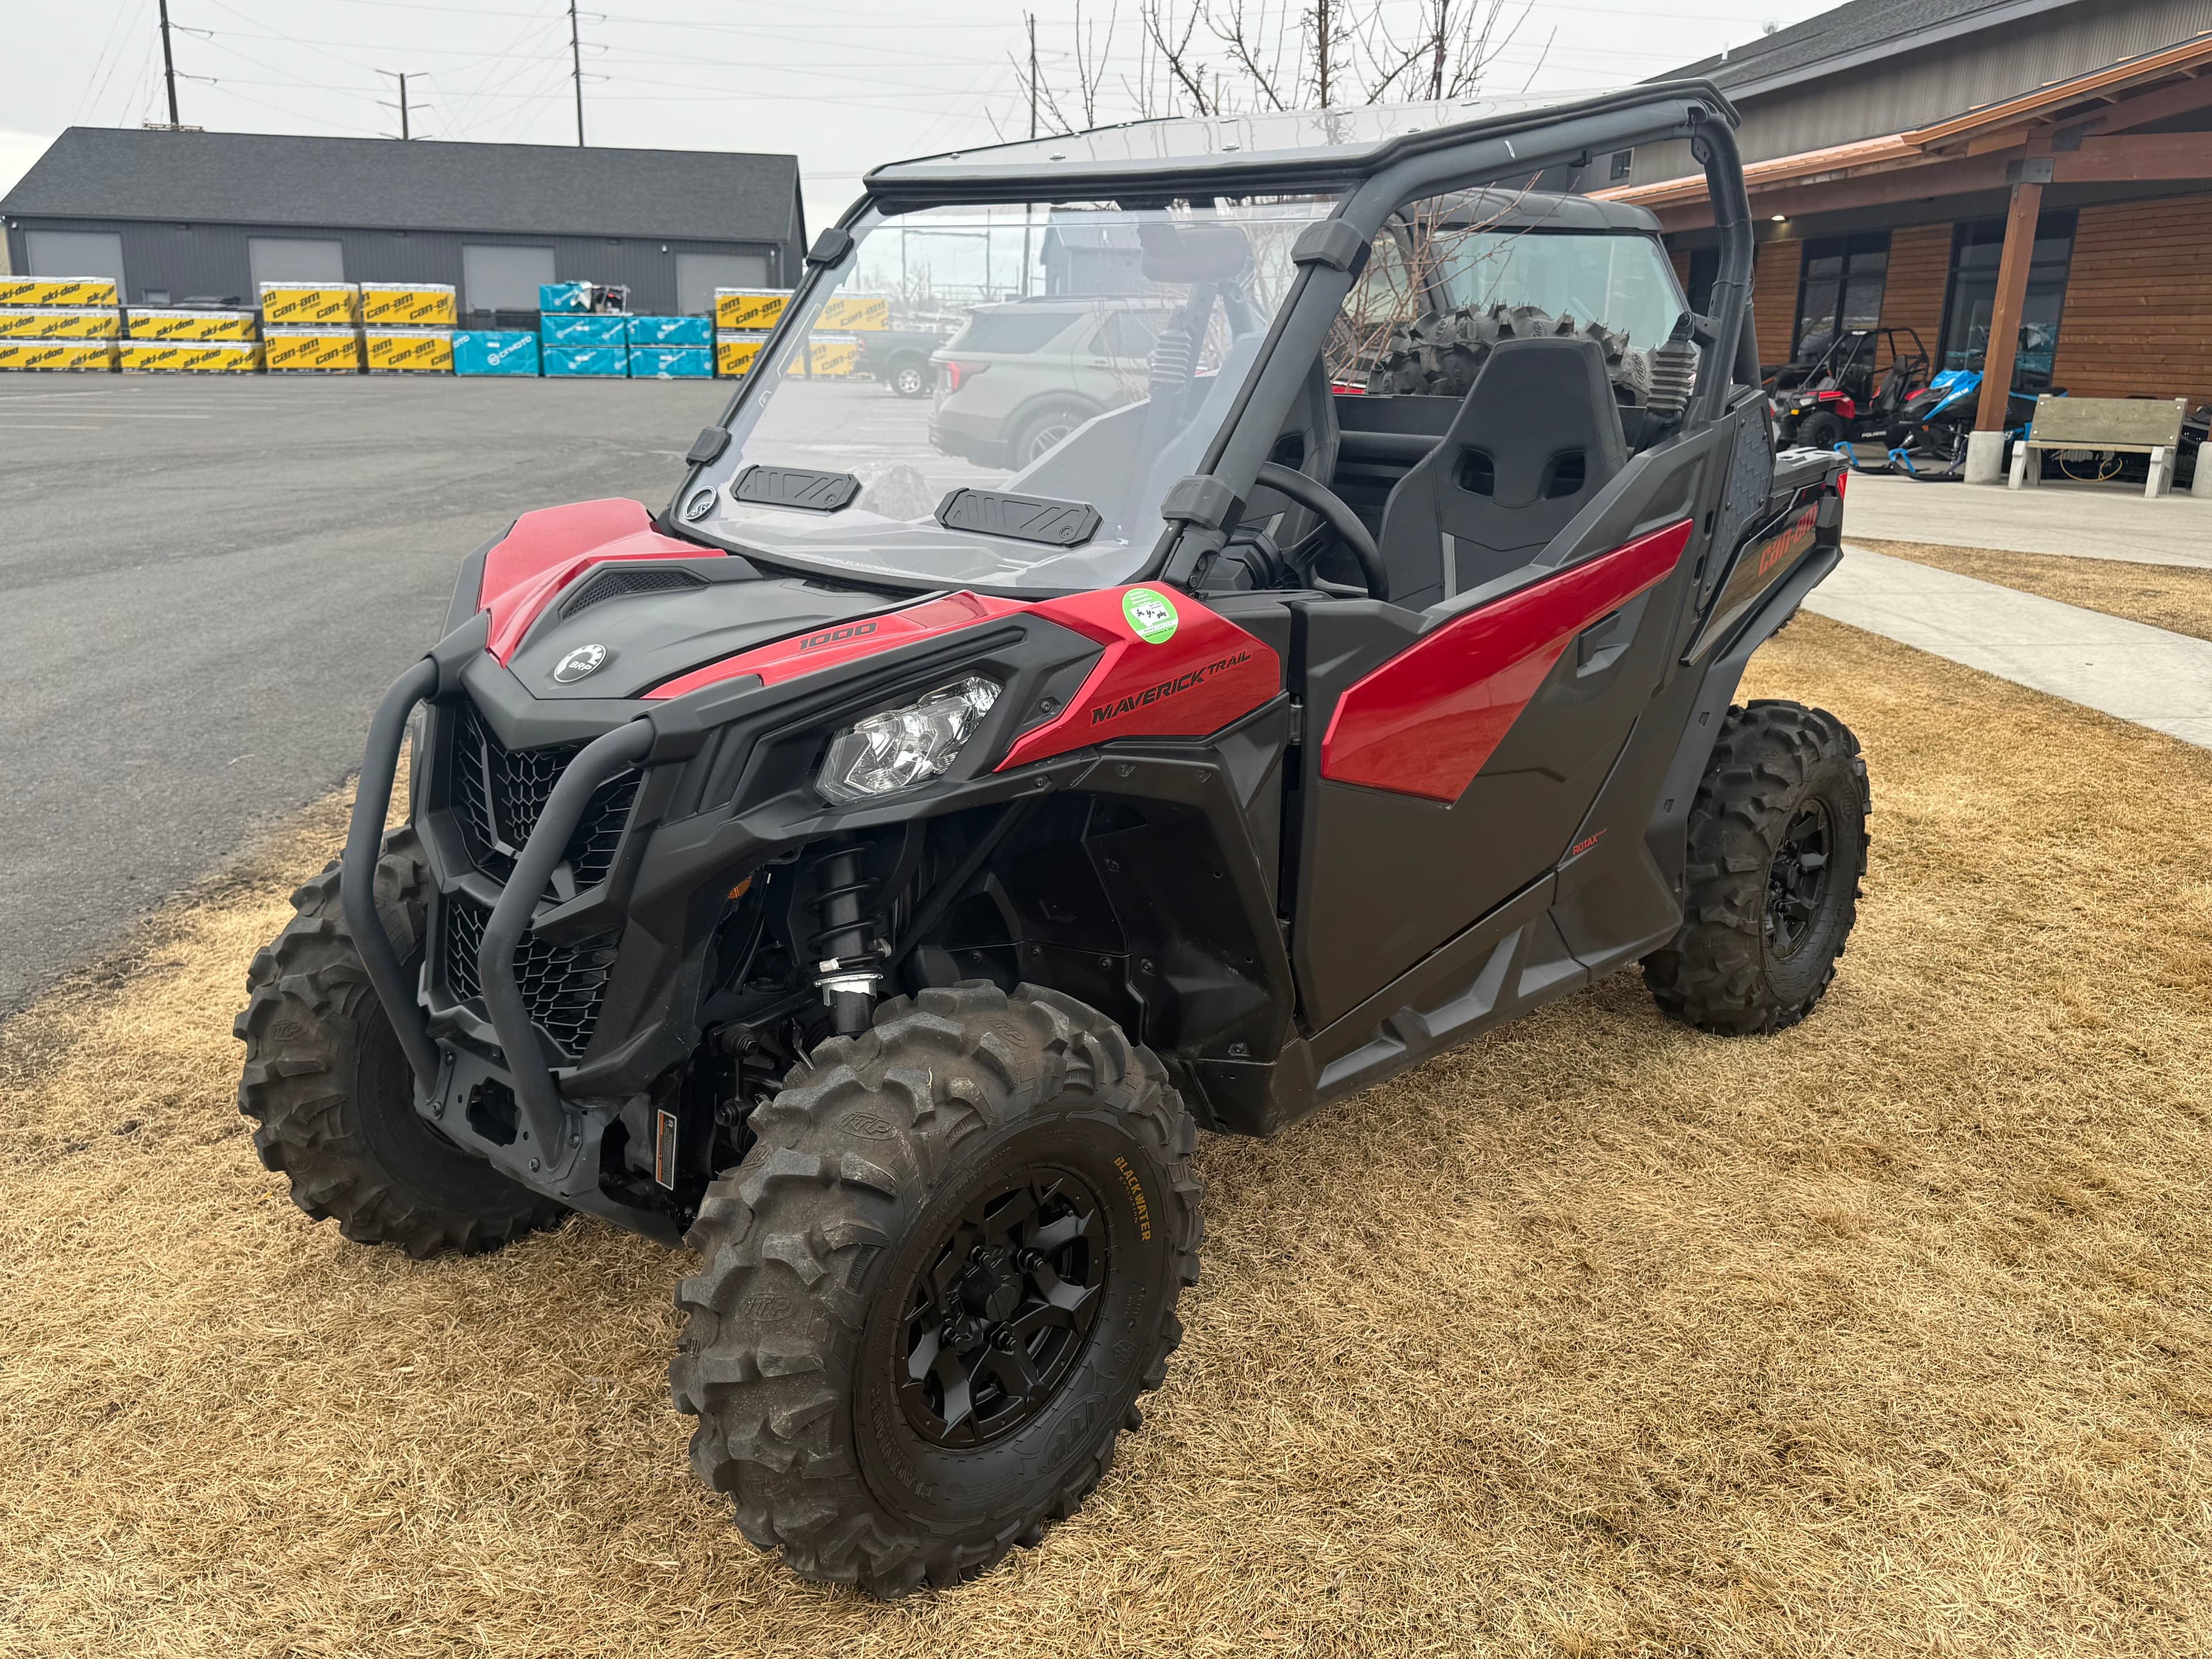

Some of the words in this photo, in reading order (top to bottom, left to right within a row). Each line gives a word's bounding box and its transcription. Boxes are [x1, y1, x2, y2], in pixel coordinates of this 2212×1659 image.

[41, 283, 81, 303] ski-doo
[273, 291, 320, 319] can-am
[366, 293, 414, 320] can-am
[736, 298, 781, 324] can-am
[41, 316, 80, 335] ski-doo
[156, 319, 195, 338] ski-doo
[200, 320, 239, 339] ski-doo
[25, 347, 63, 367] ski-doo
[70, 349, 108, 368] ski-doo
[140, 349, 177, 368] ski-doo
[183, 350, 221, 369] ski-doo
[272, 338, 319, 365] can-am
[388, 339, 435, 366] can-am
[800, 623, 877, 650] 1000
[569, 661, 592, 671] BRP
[1092, 668, 1206, 725] MAVERICK
[1209, 651, 1252, 676] TRAIL
[1573, 834, 1598, 855] ROTAX
[839, 1113, 892, 1135] ITP
[1113, 1155, 1152, 1242] BLACKWATER
[744, 1297, 791, 1317] ITP
